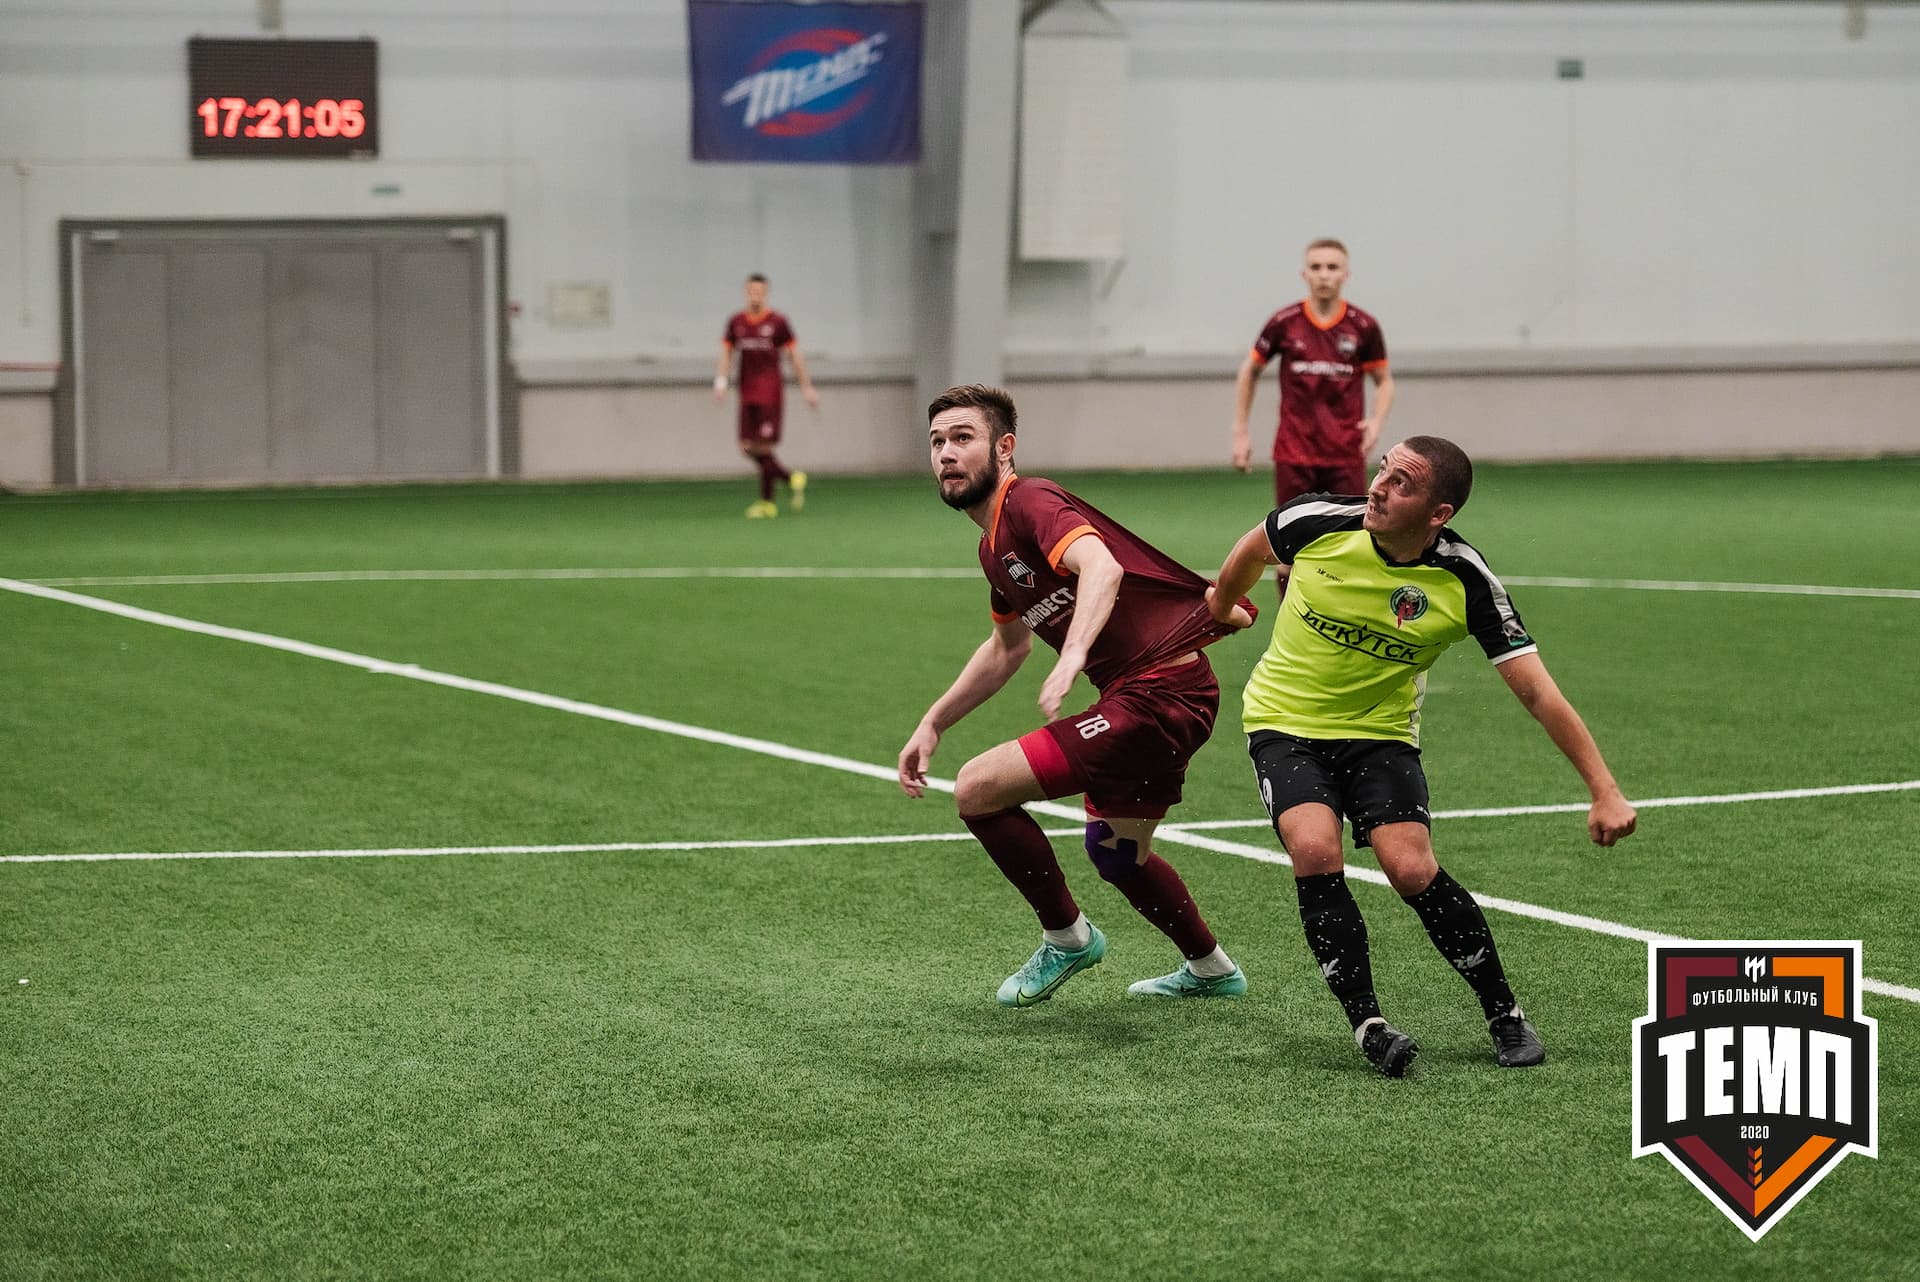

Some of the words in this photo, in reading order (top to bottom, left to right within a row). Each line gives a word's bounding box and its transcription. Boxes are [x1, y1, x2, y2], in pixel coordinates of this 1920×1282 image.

[197, 97, 366, 138] 17:21:05
[1301, 610, 1421, 661] ИРКУТСК
[1074, 713, 1111, 740] 18
